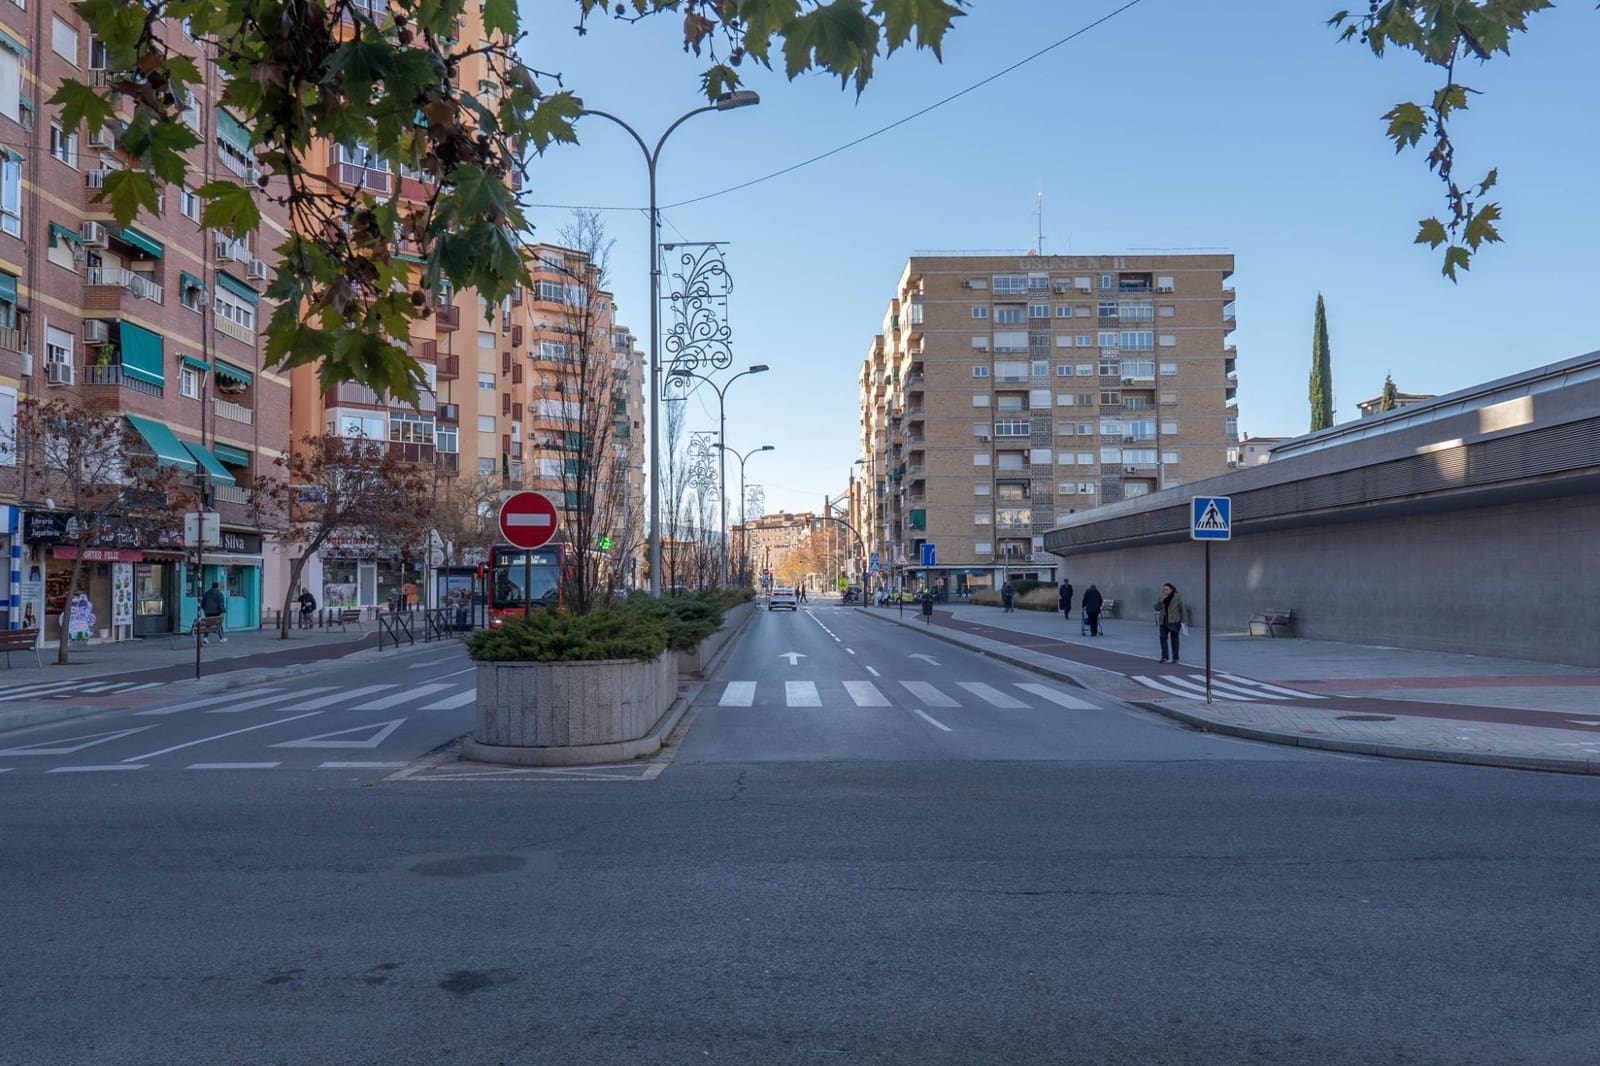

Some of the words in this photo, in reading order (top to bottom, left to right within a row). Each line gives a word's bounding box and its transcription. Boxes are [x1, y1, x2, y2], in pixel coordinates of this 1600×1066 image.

[1112, 257, 1127, 269] 11
[224, 533, 245, 550] Silva
[104, 551, 120, 560] FELIZ
